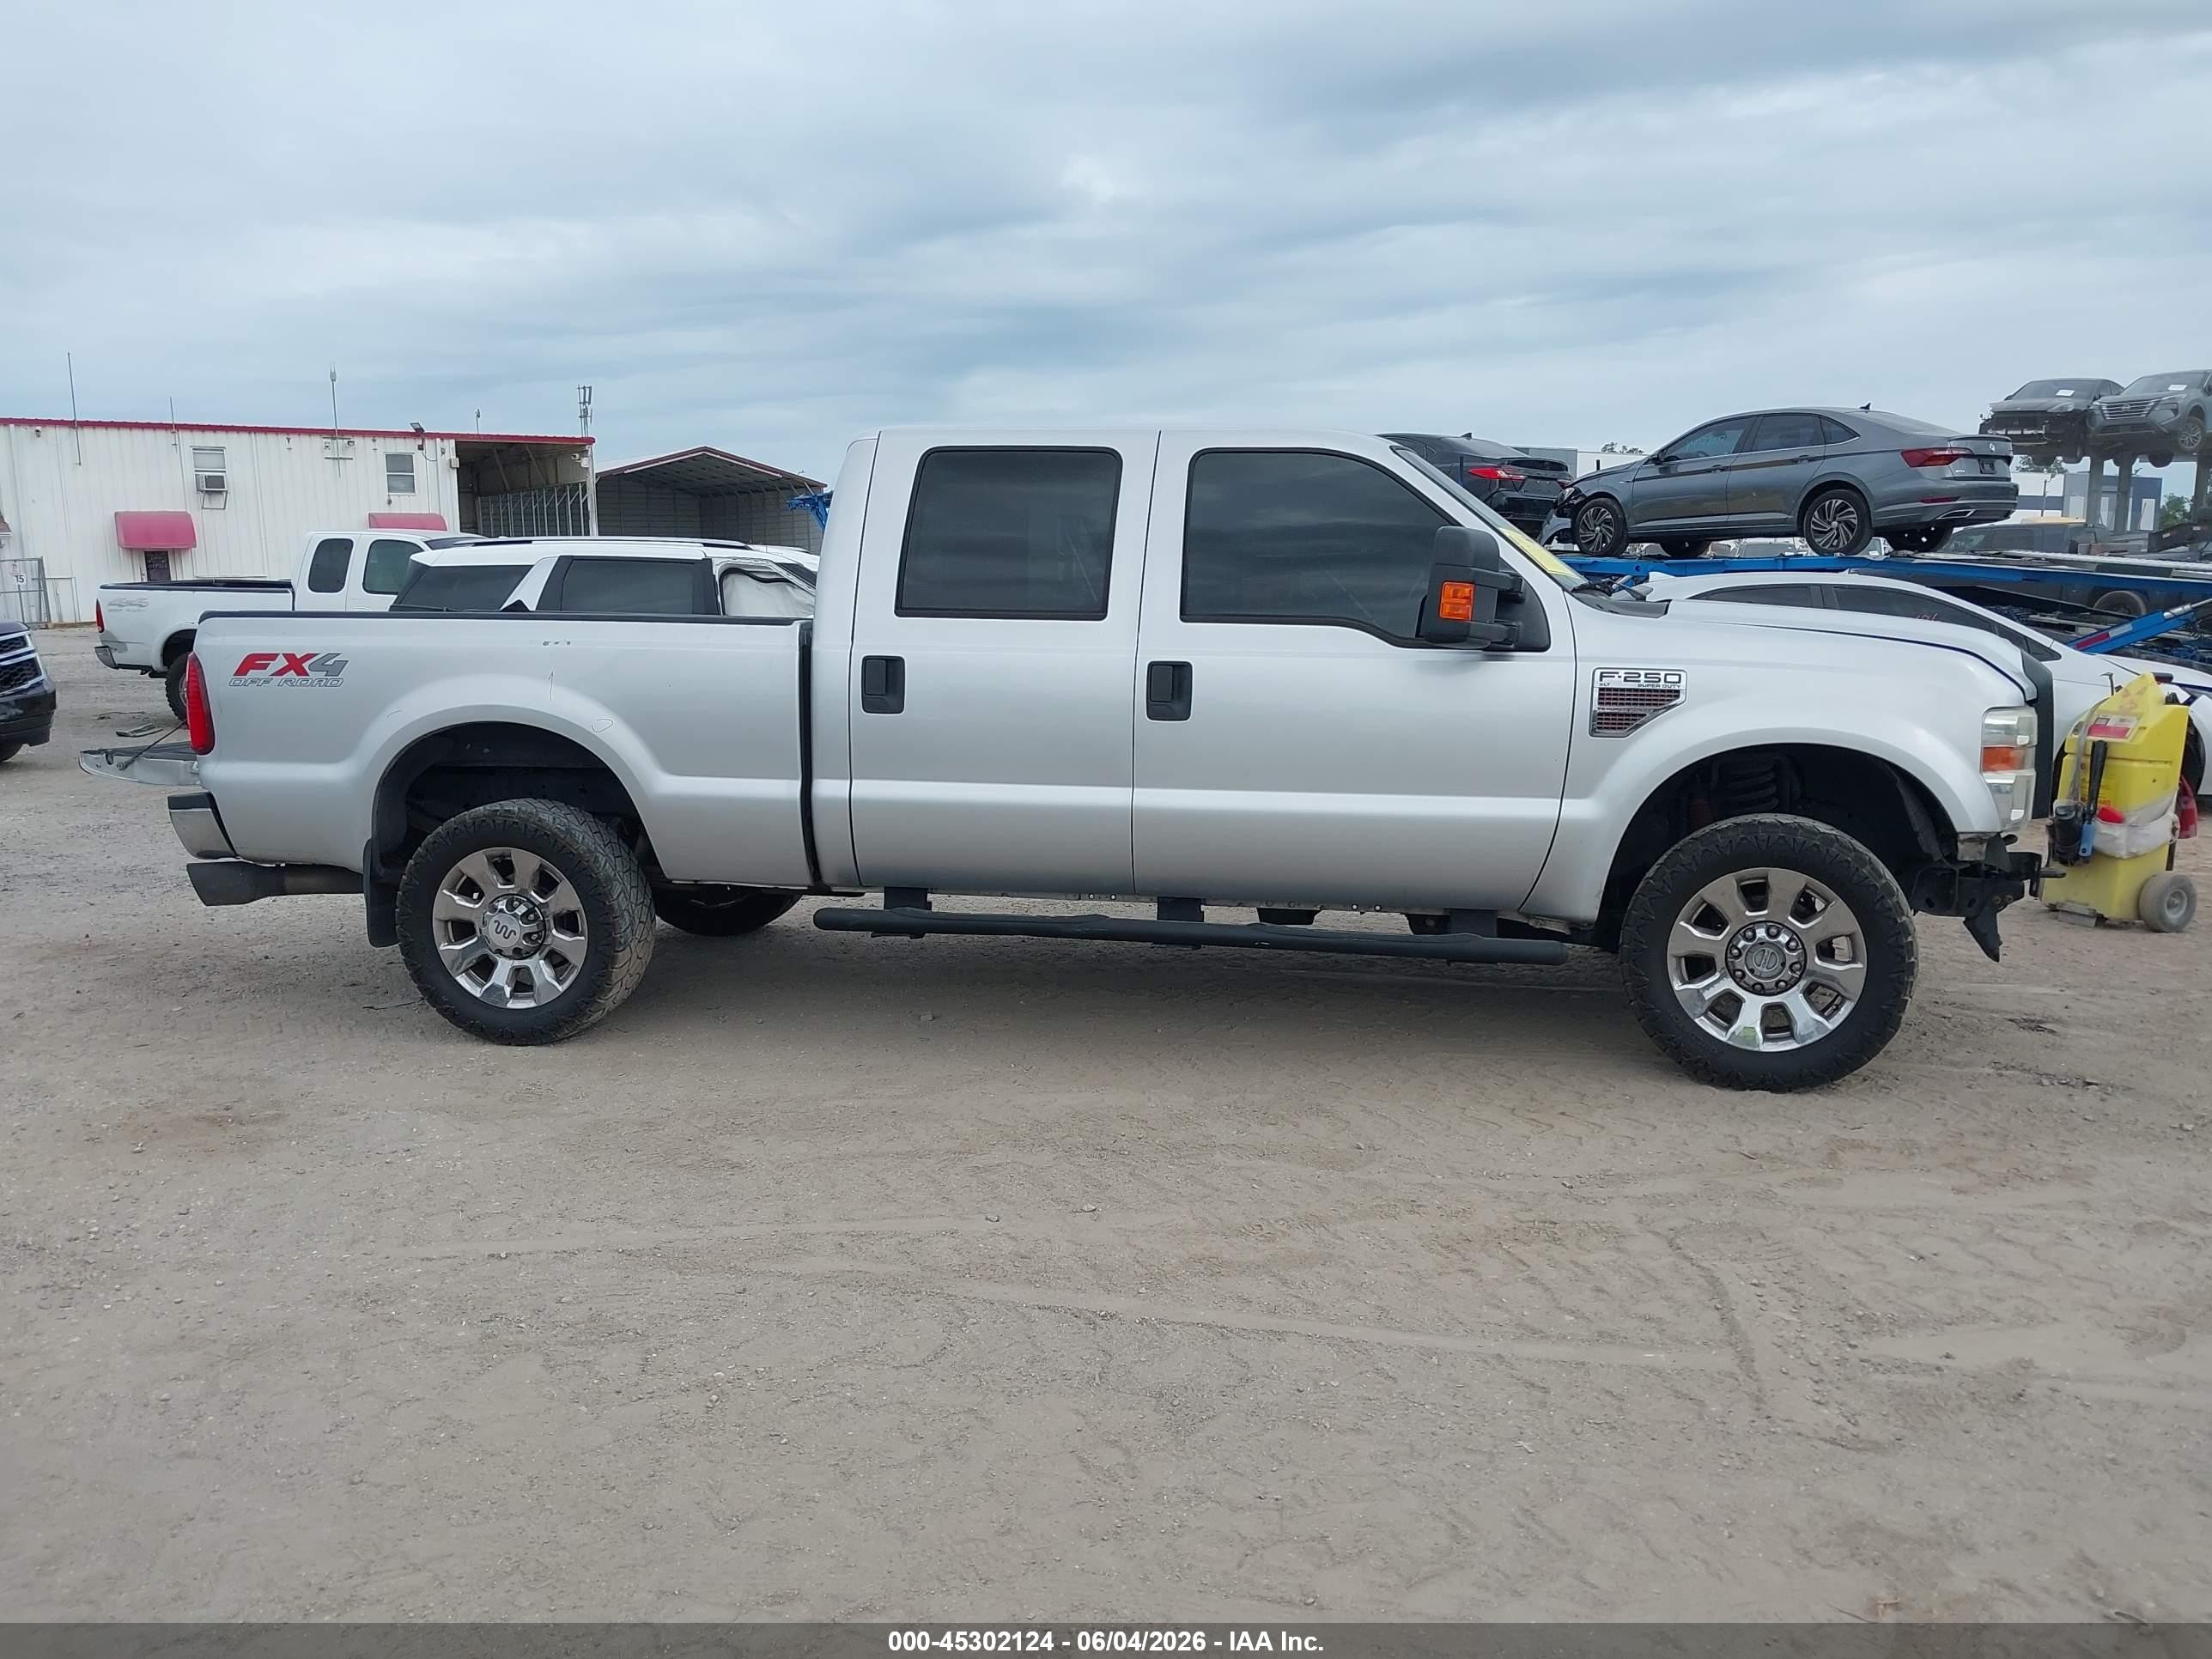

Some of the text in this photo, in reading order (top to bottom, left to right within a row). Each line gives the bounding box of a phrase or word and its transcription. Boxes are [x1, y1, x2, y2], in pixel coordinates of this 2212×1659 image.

[233, 653, 349, 677] FX4
[228, 678, 343, 687] OFF ROAD
